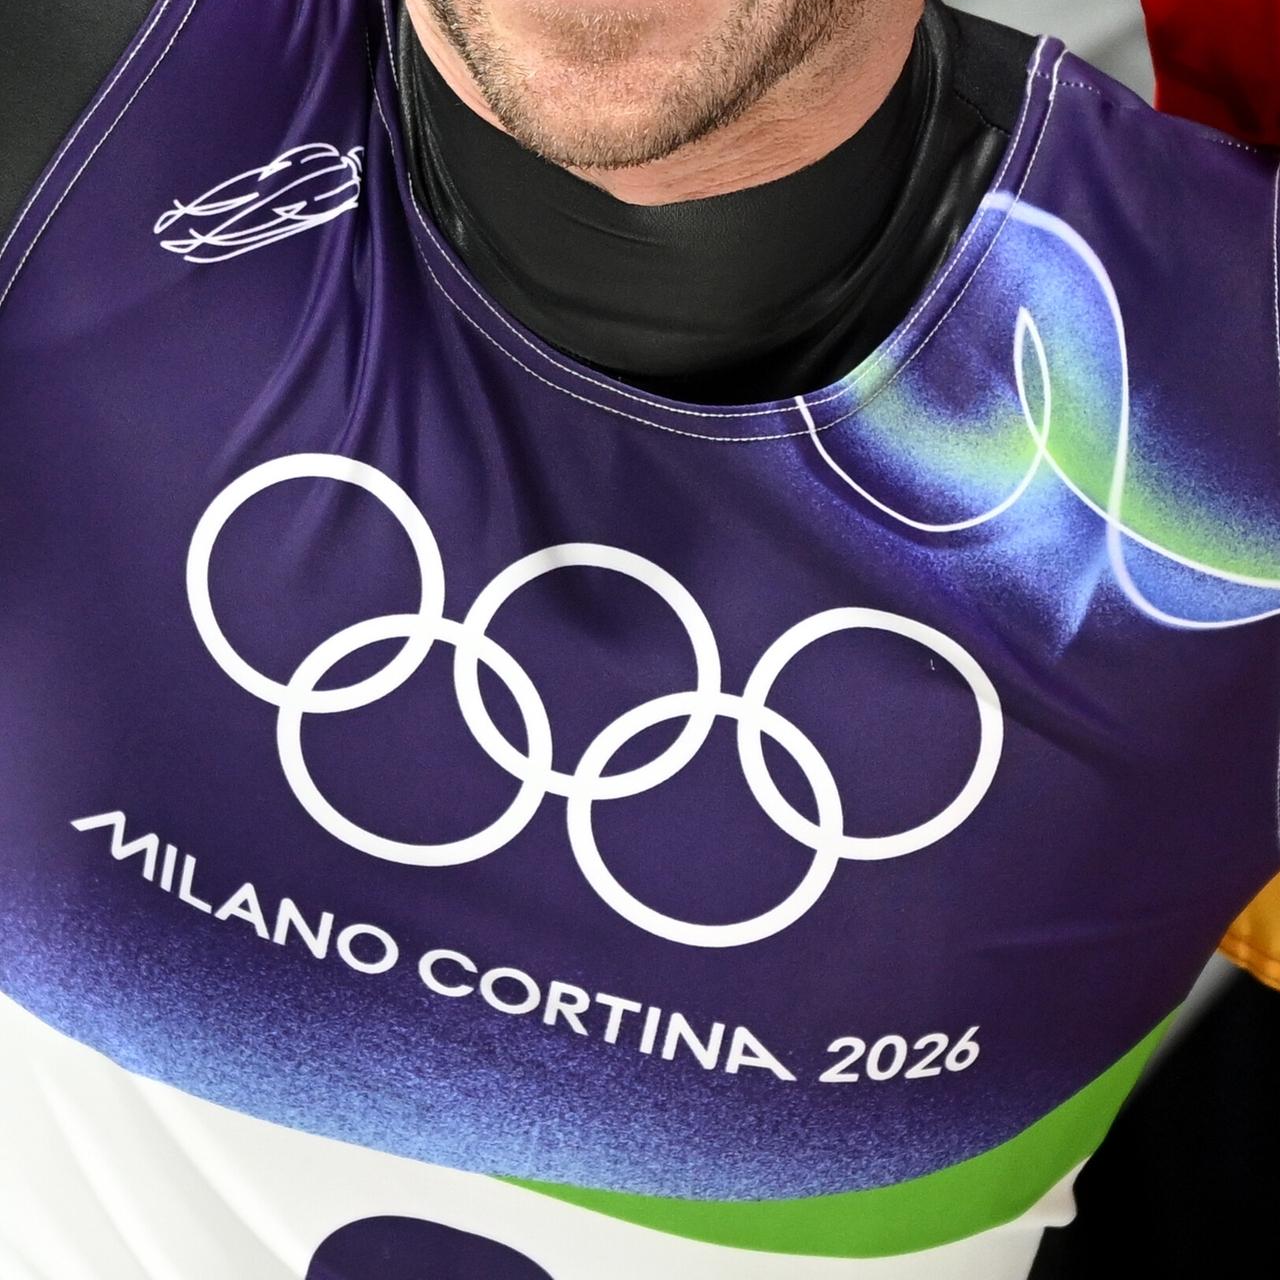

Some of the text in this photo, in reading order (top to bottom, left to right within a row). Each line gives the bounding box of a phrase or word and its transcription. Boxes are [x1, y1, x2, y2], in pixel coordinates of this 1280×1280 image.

[71, 810, 980, 1083] MILANO CORTINA 2026
